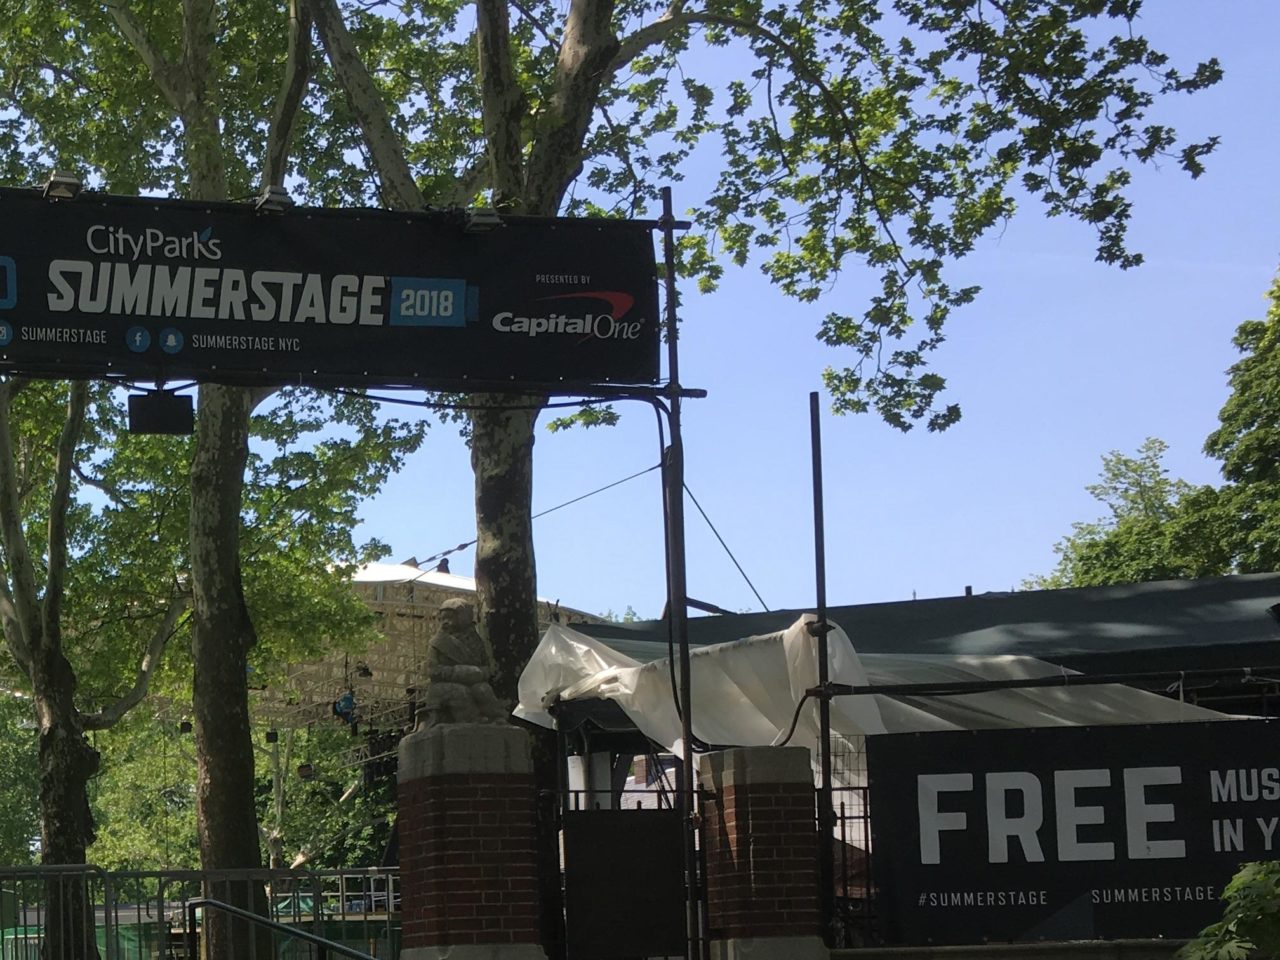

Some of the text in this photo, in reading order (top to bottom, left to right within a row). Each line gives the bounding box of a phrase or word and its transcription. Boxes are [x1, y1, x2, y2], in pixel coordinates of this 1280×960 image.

[86, 224, 222, 261] CityParks
[46, 259, 386, 326] SUMMERSTAGE
[400, 289, 453, 317] 2018
[535, 274, 591, 285] PRESENTED BY
[21, 327, 108, 344] SUMMERSTAGE
[192, 334, 301, 352] SUMMERSTAGE NYC
[917, 766, 1187, 865] FREE
[1212, 818, 1245, 852] IN
[919, 890, 1048, 907] #SUMMERSTAGE
